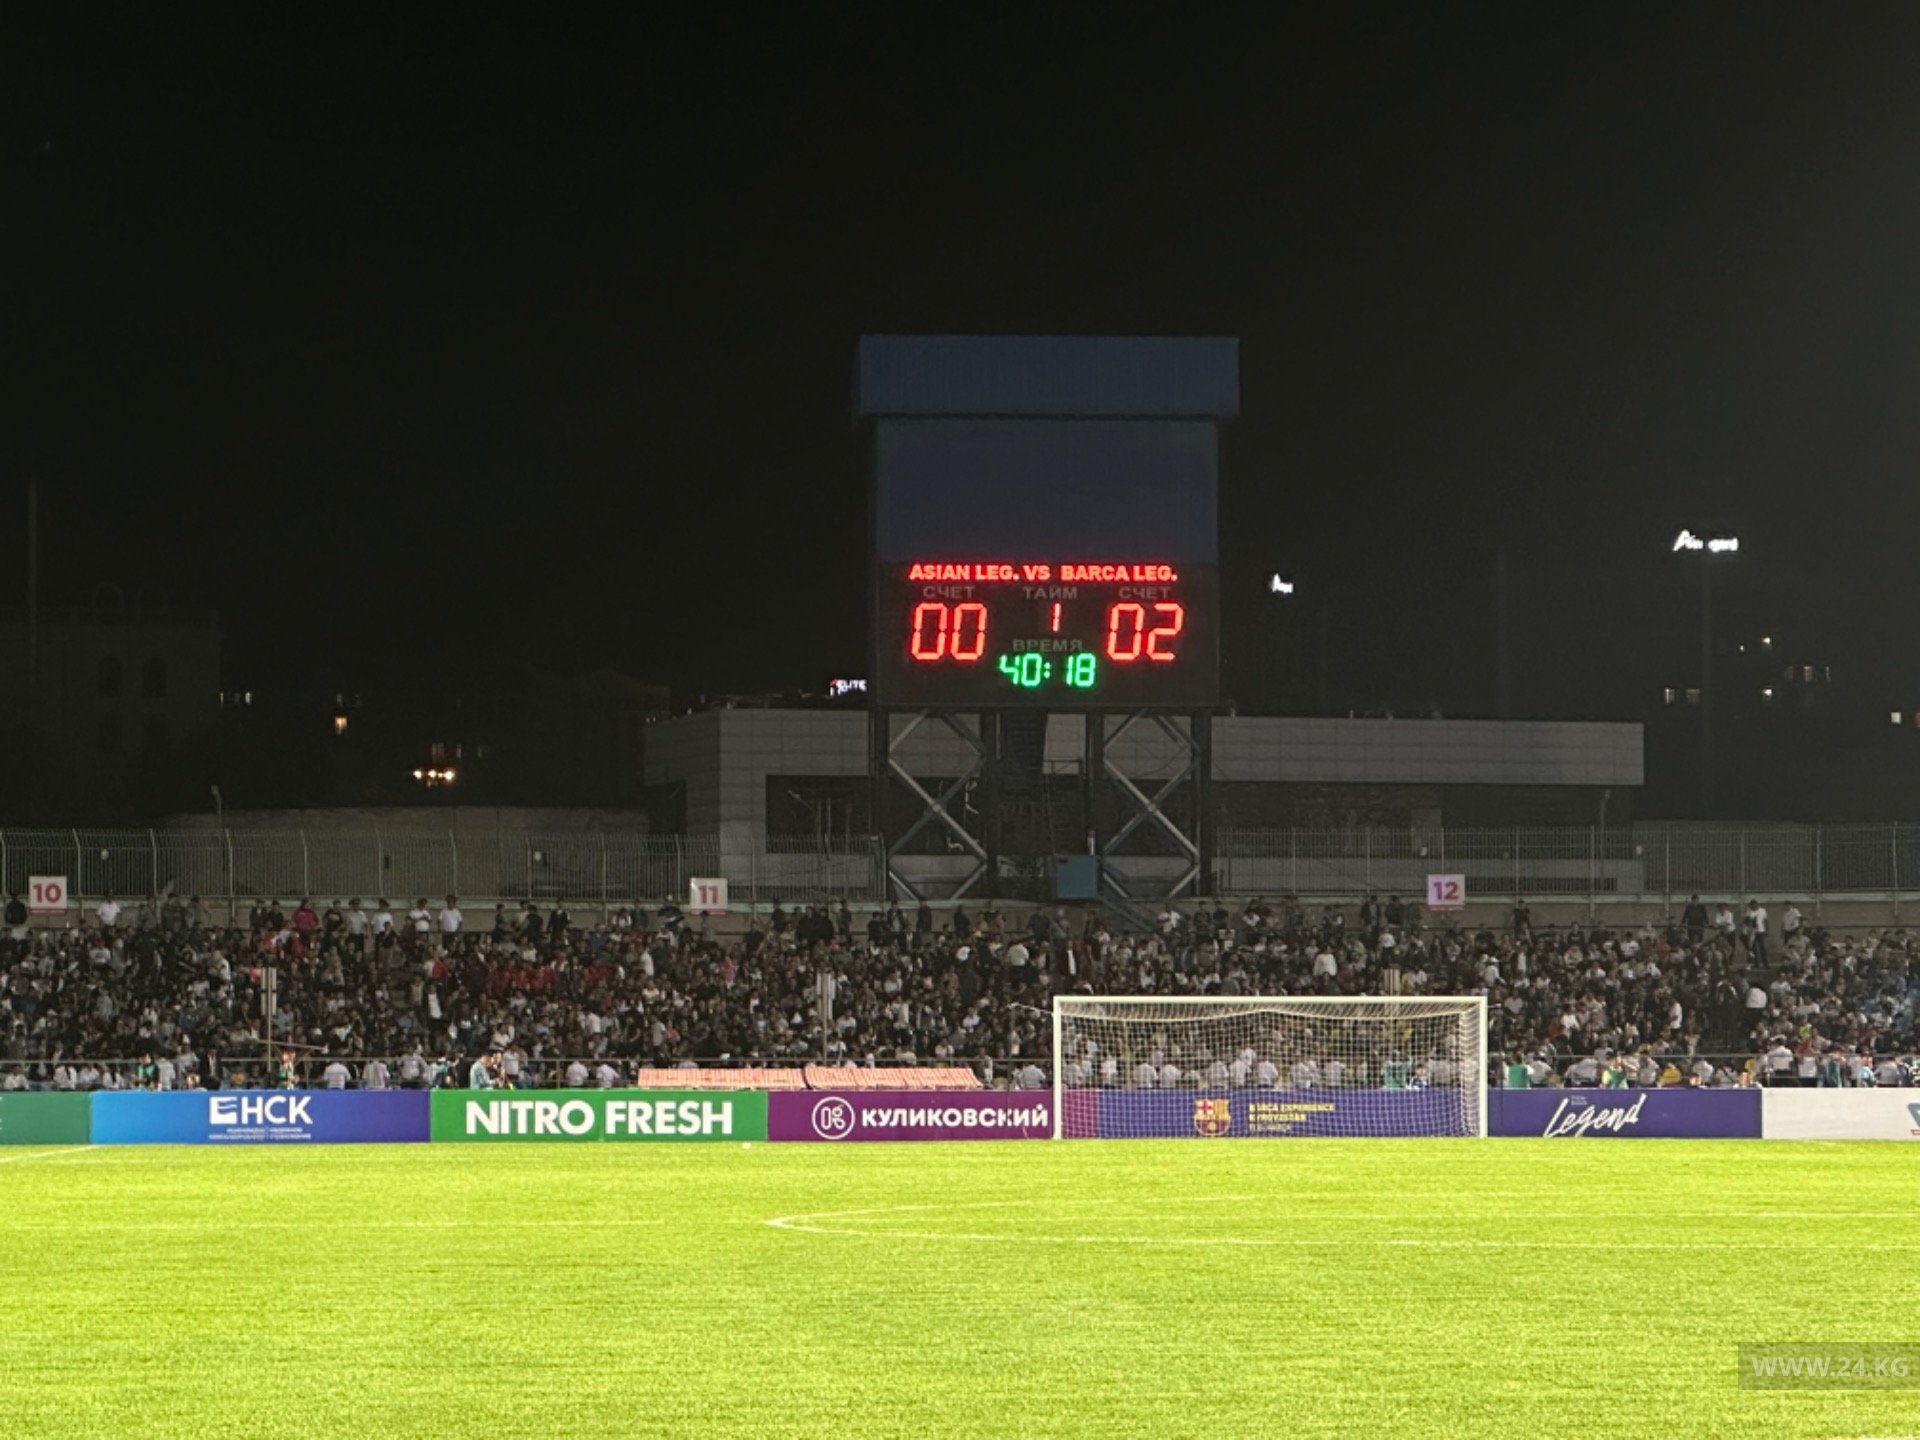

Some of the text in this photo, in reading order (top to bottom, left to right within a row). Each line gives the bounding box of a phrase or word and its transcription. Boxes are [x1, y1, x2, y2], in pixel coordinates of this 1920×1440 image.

[909, 564, 1178, 581] ASIAN LEG. VS BARCA LEG.
[923, 586, 976, 599] СЧЕТ
[1022, 584, 1078, 599] ТАЙМ
[1119, 586, 1172, 599] СЧЕТ
[1053, 603, 1061, 632] 1
[911, 602, 988, 661] 00
[1107, 602, 1184, 661] 02
[1013, 639, 1082, 652] ВРЕМЯ
[33, 883, 62, 903] 10
[698, 885, 718, 905] 11
[1433, 881, 1459, 900] 12
[466, 1100, 733, 1135] NITRO FRESH
[862, 1104, 1048, 1127] КУЛИКОВСКИЙ
[1543, 1093, 1647, 1138] Legend
